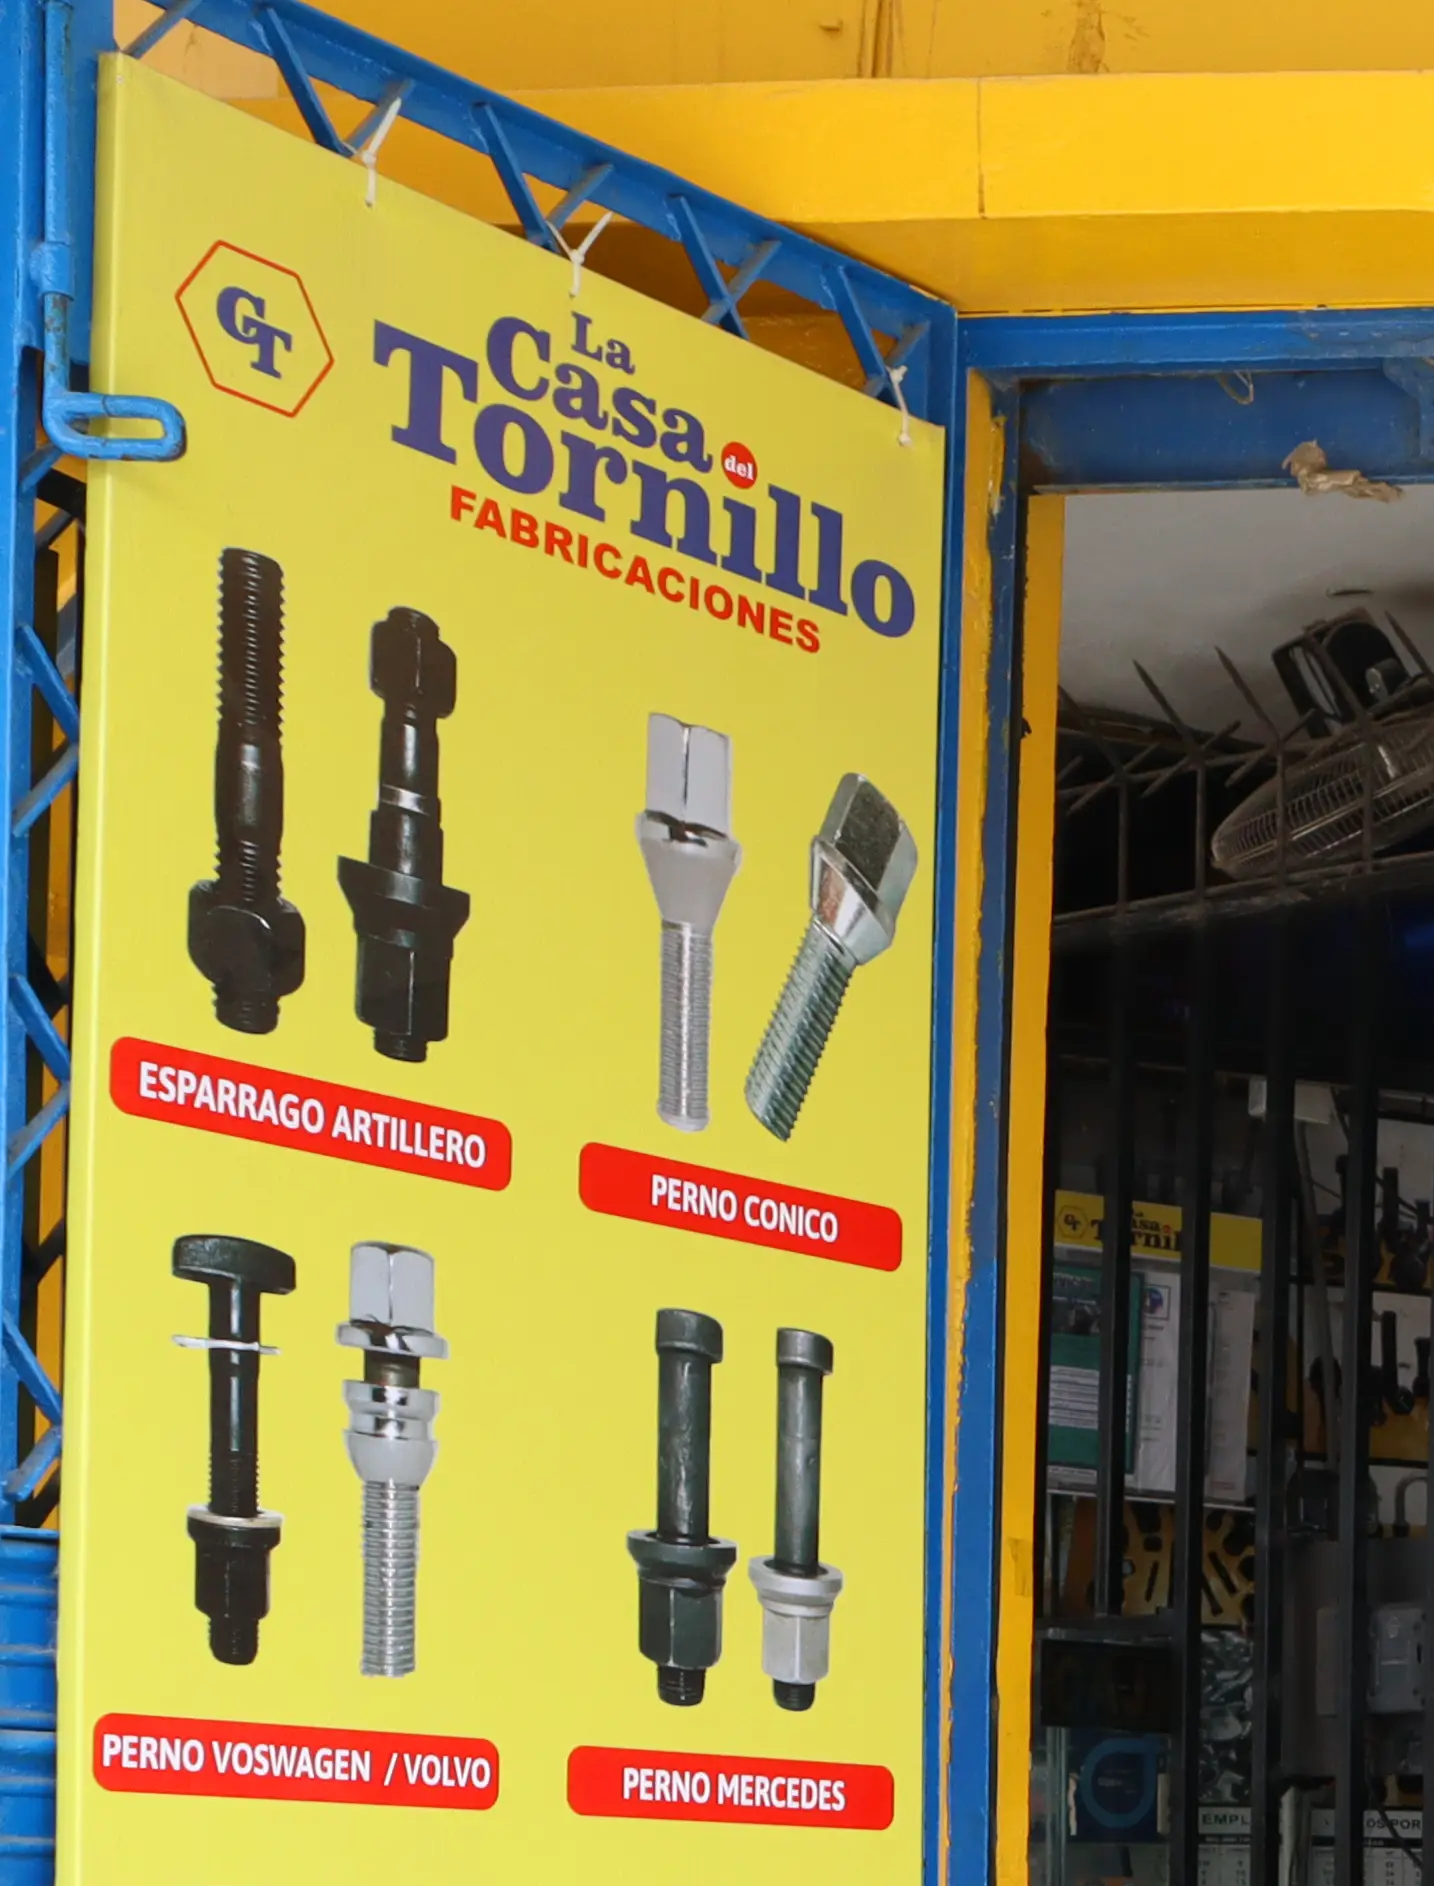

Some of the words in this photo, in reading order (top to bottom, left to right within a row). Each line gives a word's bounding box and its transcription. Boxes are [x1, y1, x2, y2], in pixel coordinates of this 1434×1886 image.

[217, 287, 292, 380] GT
[570, 312, 635, 373] La
[486, 316, 713, 473] Casa
[374, 322, 916, 638] Tornillo
[726, 455, 755, 482] del
[451, 486, 820, 653] FABRICACIONES
[141, 1062, 323, 1132] ESPARRAGO
[332, 1106, 484, 1167] ARTILLERO
[653, 1175, 736, 1220] PERNO
[745, 1196, 837, 1241] CONICO
[104, 1735, 204, 1771] PERNO
[212, 1742, 370, 1781] VOSWAGEN
[404, 1754, 490, 1788] VOLVO
[624, 1768, 710, 1803] PERNO
[719, 1774, 844, 1810] MERCEDES
